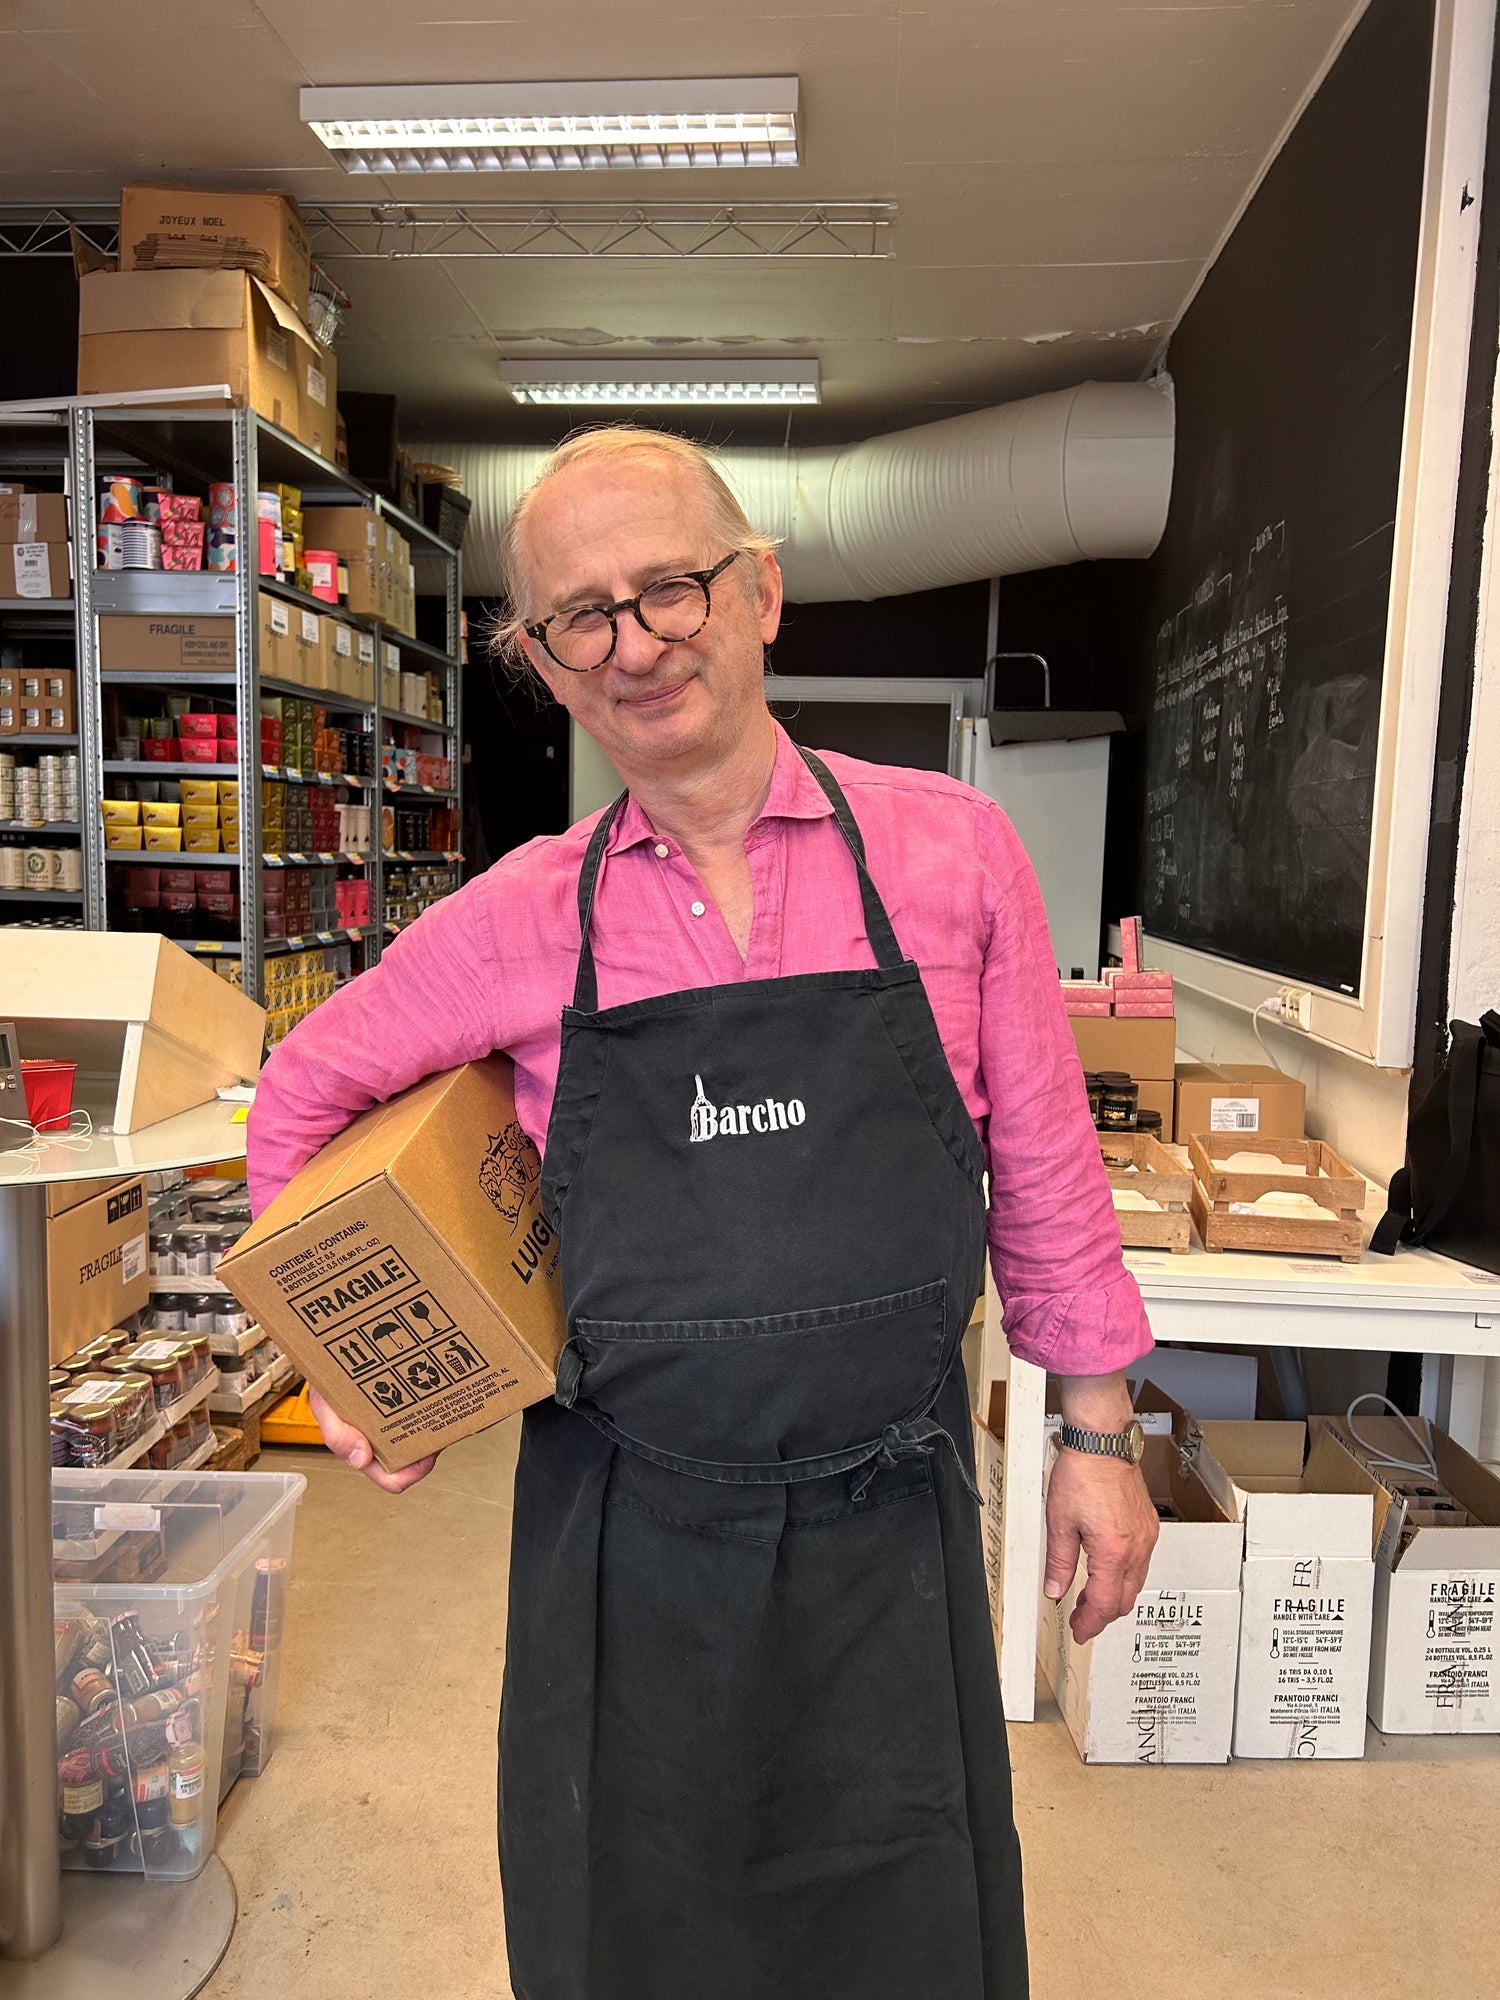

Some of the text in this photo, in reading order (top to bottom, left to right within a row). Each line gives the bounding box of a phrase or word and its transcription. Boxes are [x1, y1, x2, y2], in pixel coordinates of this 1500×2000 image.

[160, 216, 225, 226] JOYEUX NOEL
[150, 624, 195, 635] FRAGILE
[692, 1098, 806, 1141] Barcho
[80, 1245, 123, 1284] FRAGILE
[269, 1249, 316, 1278] CONTIENE
[319, 1220, 369, 1251] CONTAINS:
[282, 1261, 316, 1284] BOTTIGLIE
[288, 1271, 318, 1291] BOTTLES
[328, 1259, 338, 1270] 0,5
[301, 1258, 407, 1325] FRAGILE
[380, 1412, 417, 1433] CONSERVARE
[442, 1390, 467, 1404] FRESCO
[390, 1433, 410, 1445] STORE
[439, 1412, 453, 1424] DRY
[453, 1401, 472, 1415] PLACE
[472, 1395, 485, 1405] AND
[485, 1387, 501, 1400] AWAY
[502, 1378, 519, 1391] FROM
[401, 1418, 422, 1431] RIPARO
[429, 1407, 446, 1419] LUCE
[450, 1396, 468, 1409] FONTI
[473, 1381, 497, 1398] CALORE
[431, 1403, 486, 1433] HEAT AND SUNLIGHT
[1292, 1559, 1312, 1588] FR
[1431, 1583, 1495, 1595] FRAGILE
[1137, 1606, 1203, 1618] FRAGILE
[1274, 1599, 1344, 1612] FRAGILE
